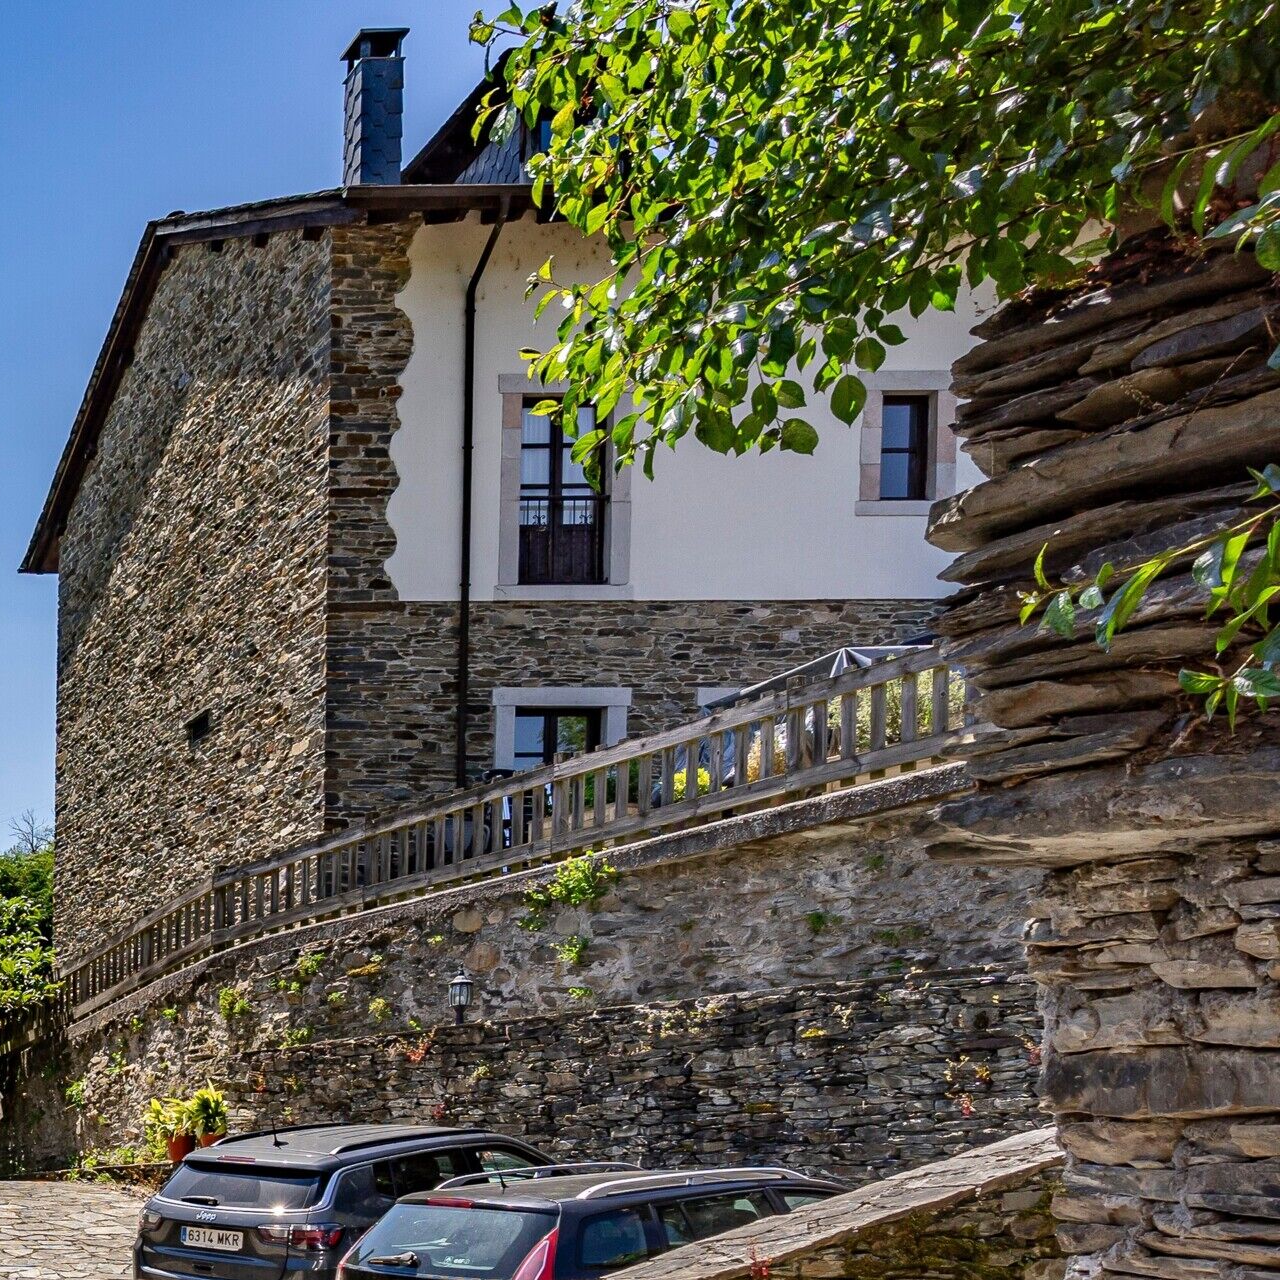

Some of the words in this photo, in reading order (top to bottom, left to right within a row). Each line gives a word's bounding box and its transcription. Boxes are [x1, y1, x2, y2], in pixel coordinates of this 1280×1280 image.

[196, 1210, 217, 1222] Jeep
[188, 1229, 214, 1244] 6314
[217, 1232, 240, 1247] MKR
